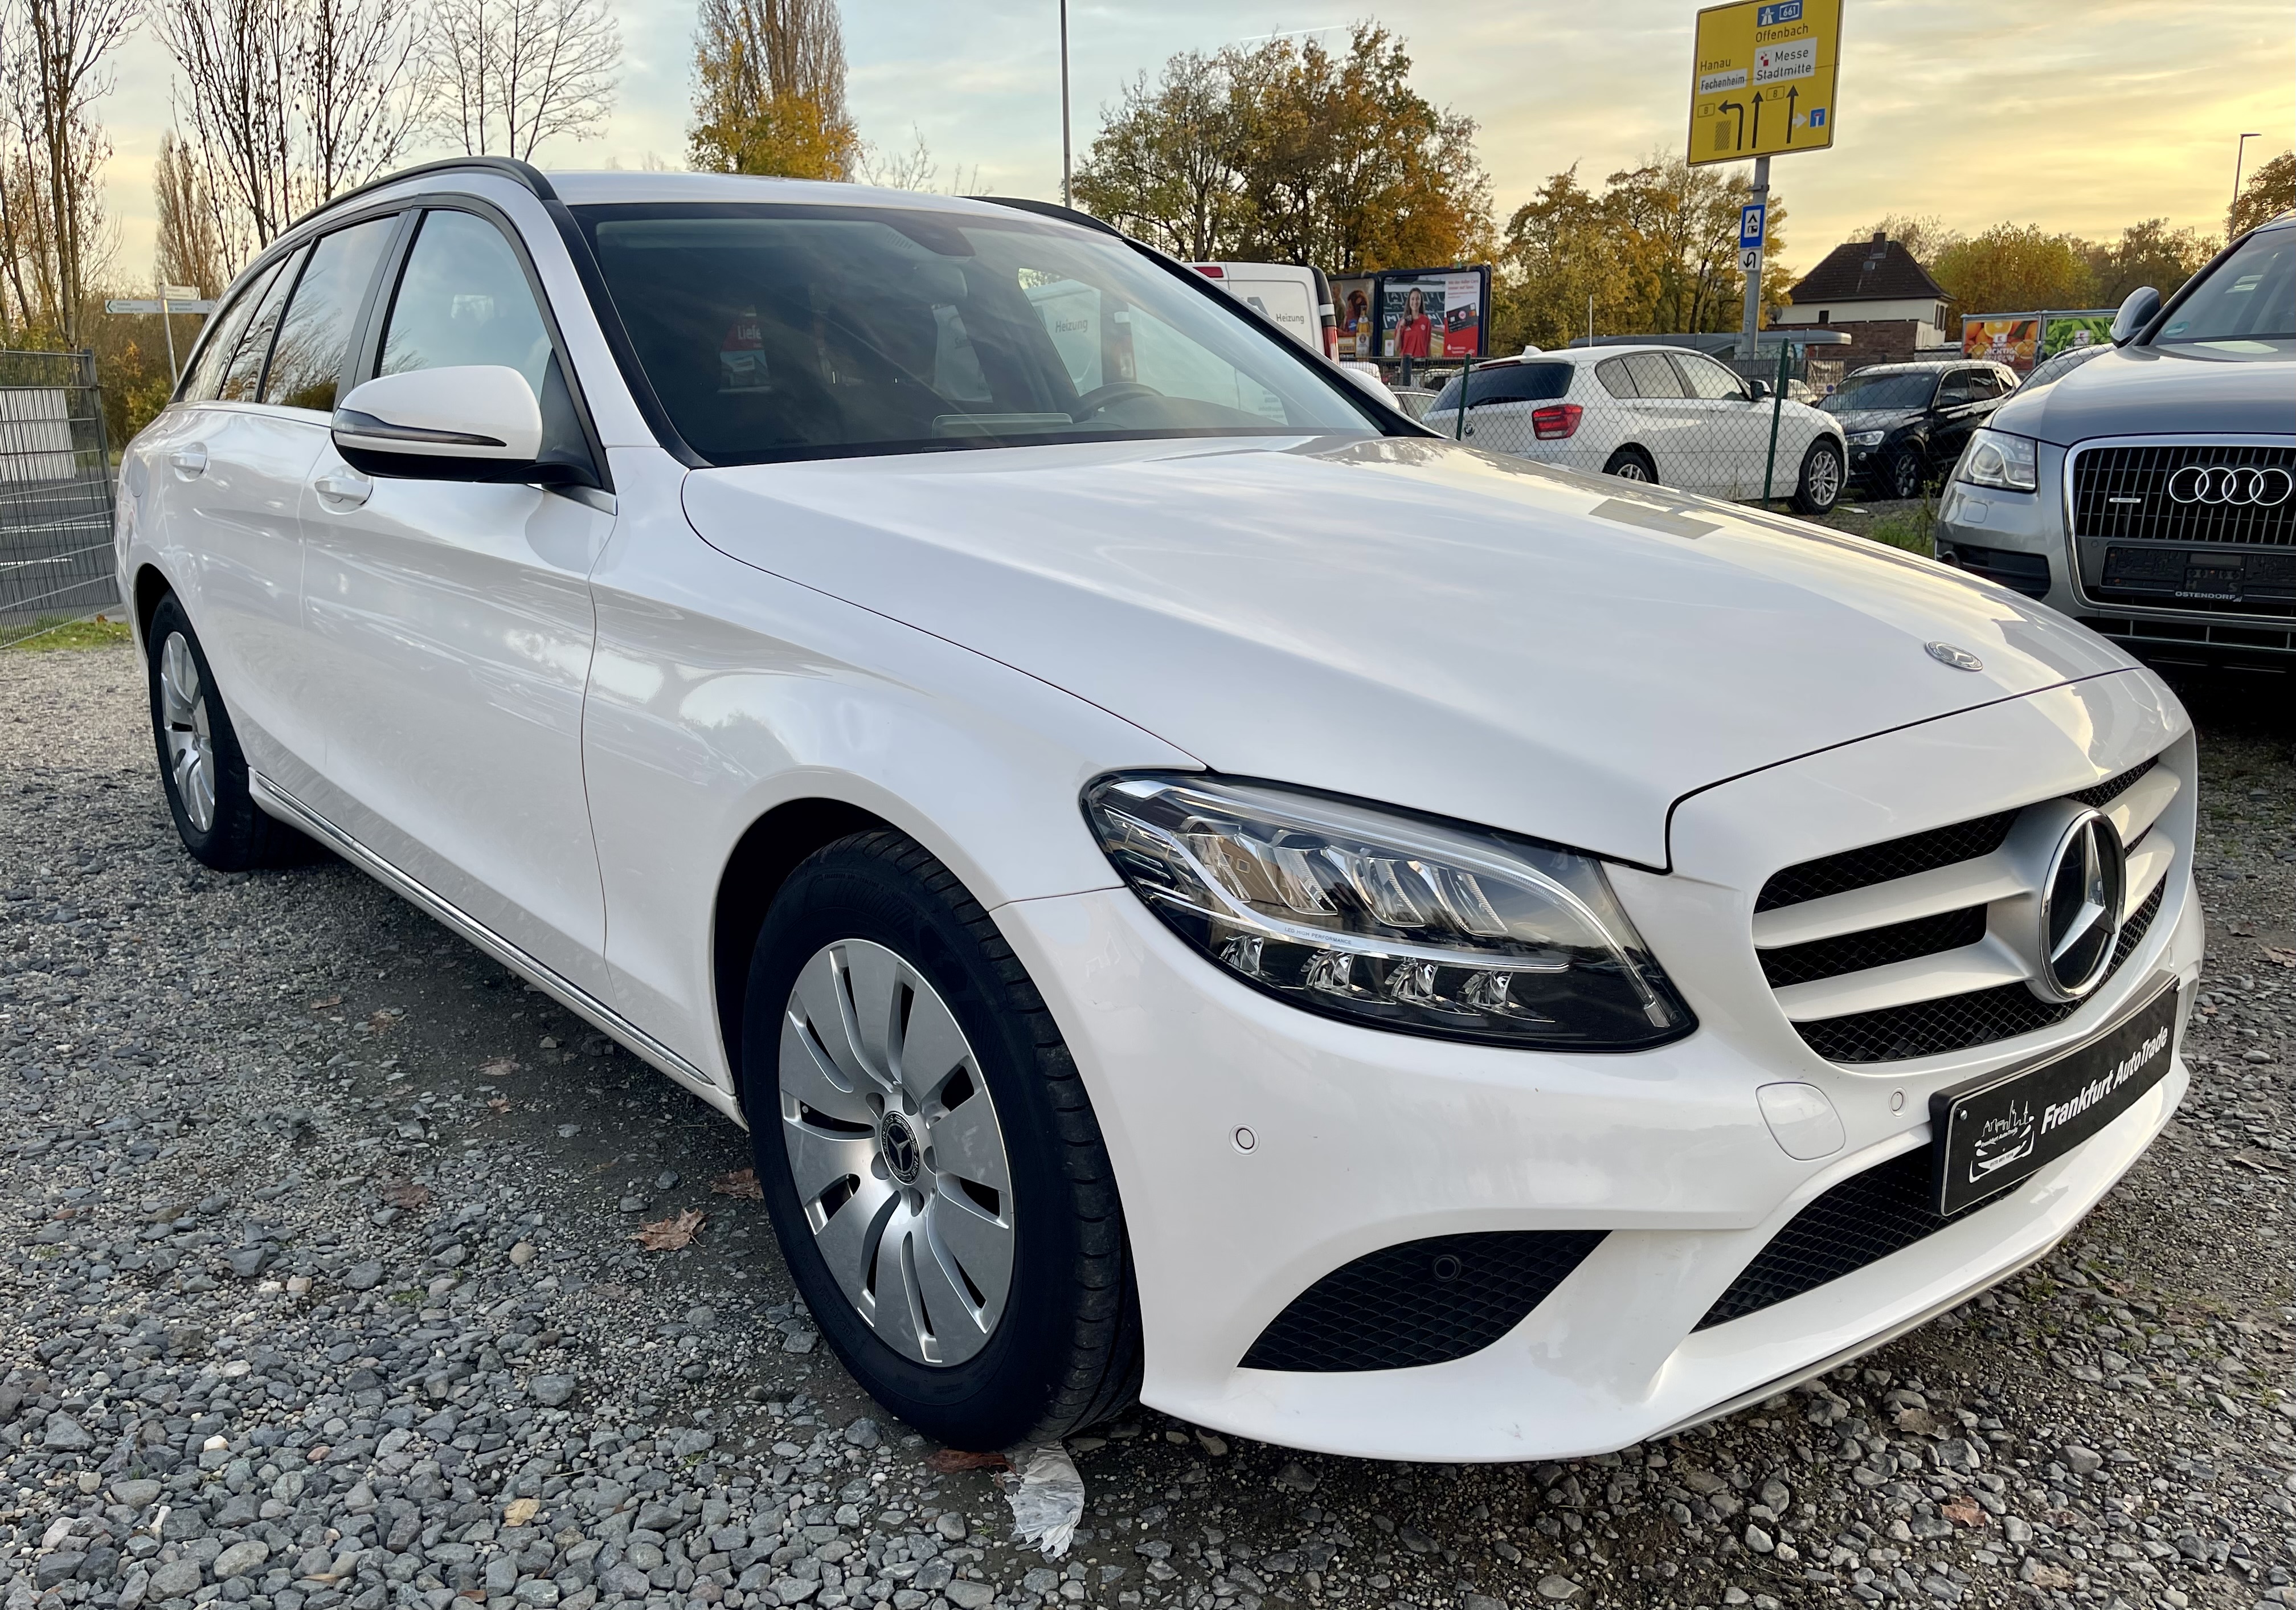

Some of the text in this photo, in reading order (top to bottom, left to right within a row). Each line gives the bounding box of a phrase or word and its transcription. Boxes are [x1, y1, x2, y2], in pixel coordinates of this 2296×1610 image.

[1783, 6, 1796, 17] 661
[1755, 23, 1808, 43] Offenbach
[1775, 49, 1808, 62] Messe
[1700, 59, 1731, 72] Hanau
[1756, 63, 1811, 81] Stadtmitte
[1701, 75, 1745, 91] Fechenheim
[1276, 313, 1305, 324] Heizung
[1055, 319, 1087, 333] Heizung
[2175, 591, 2236, 600] OSTENDORF
[1311, 933, 1352, 945] PERFORMANCE
[2040, 1026, 2168, 1135] Frankfurt AutoTrade
